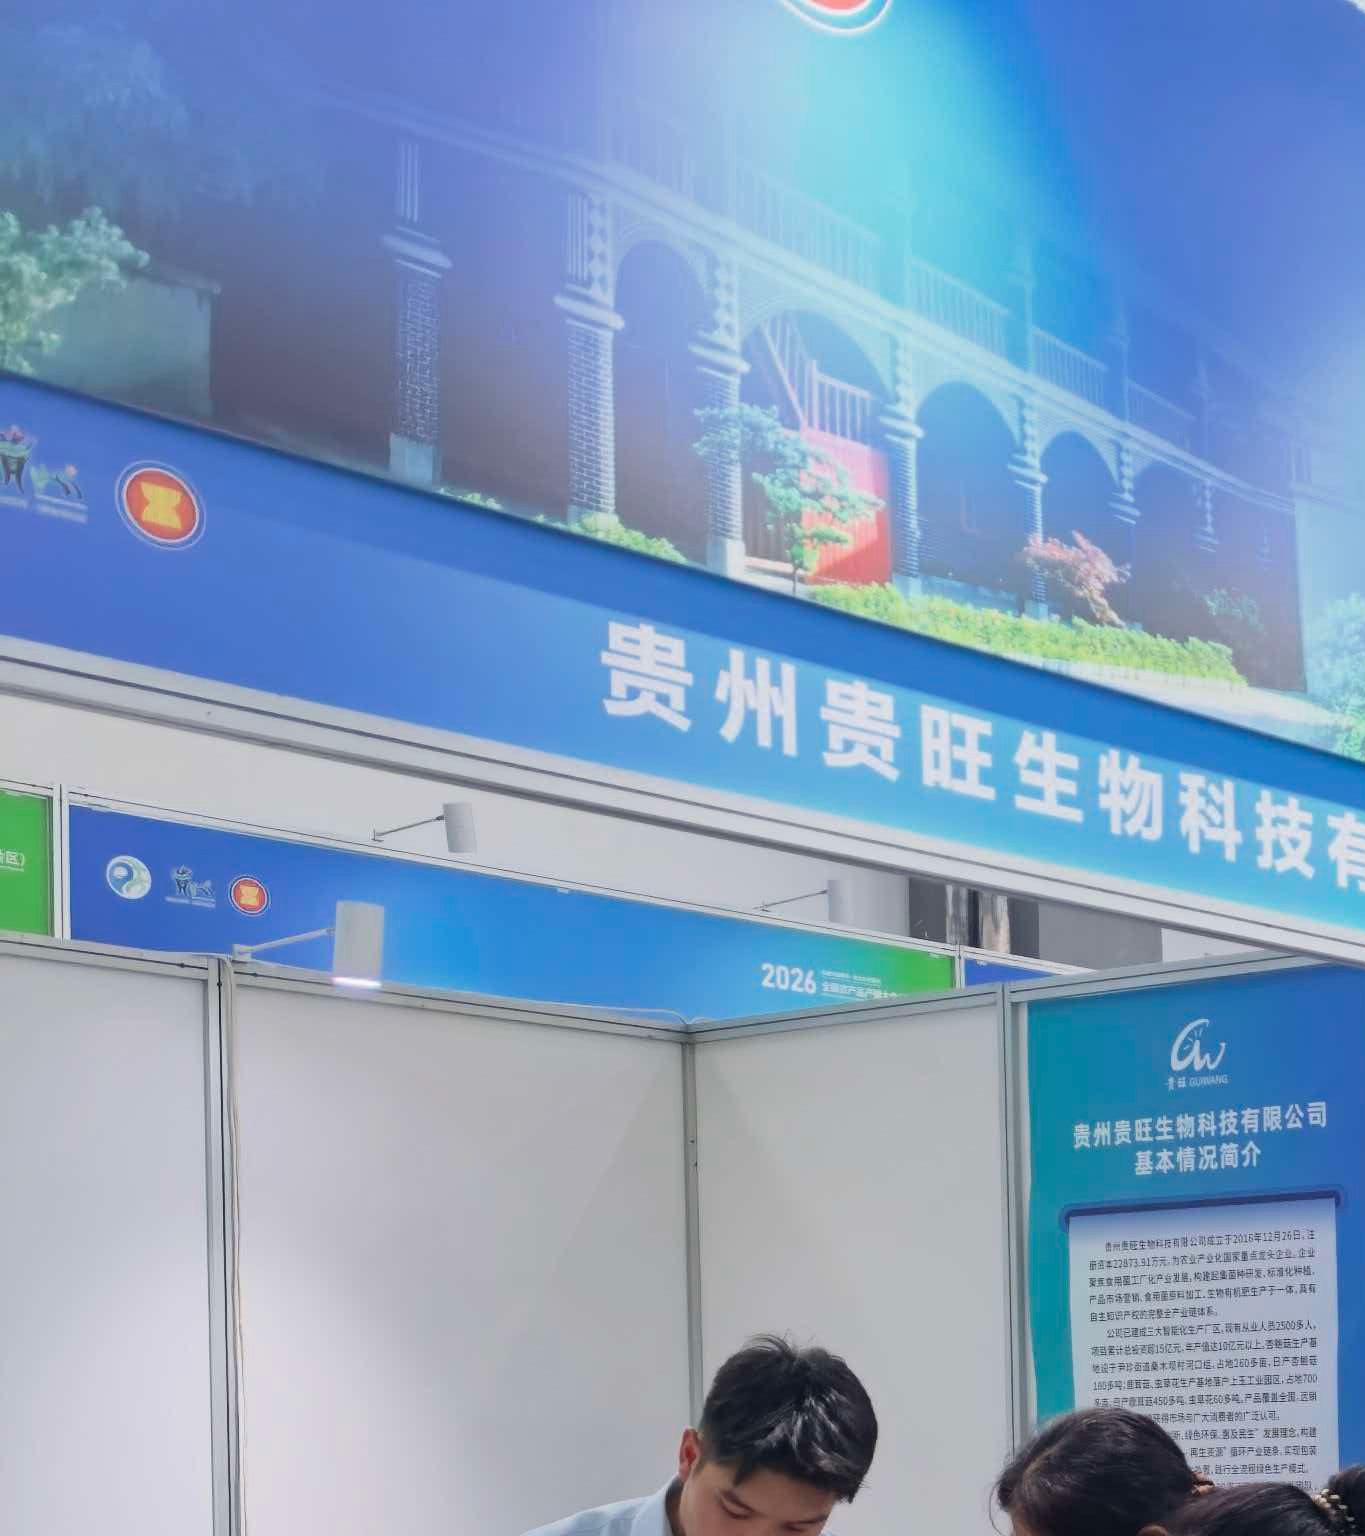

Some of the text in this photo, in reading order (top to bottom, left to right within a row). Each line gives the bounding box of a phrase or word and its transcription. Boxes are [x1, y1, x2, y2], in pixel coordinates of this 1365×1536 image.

[761, 962, 817, 995] 2026
[1072, 1101, 1327, 1150] 贵州贵旺生物科技有限公司
[1134, 1141, 1262, 1176] 基本情况简介
